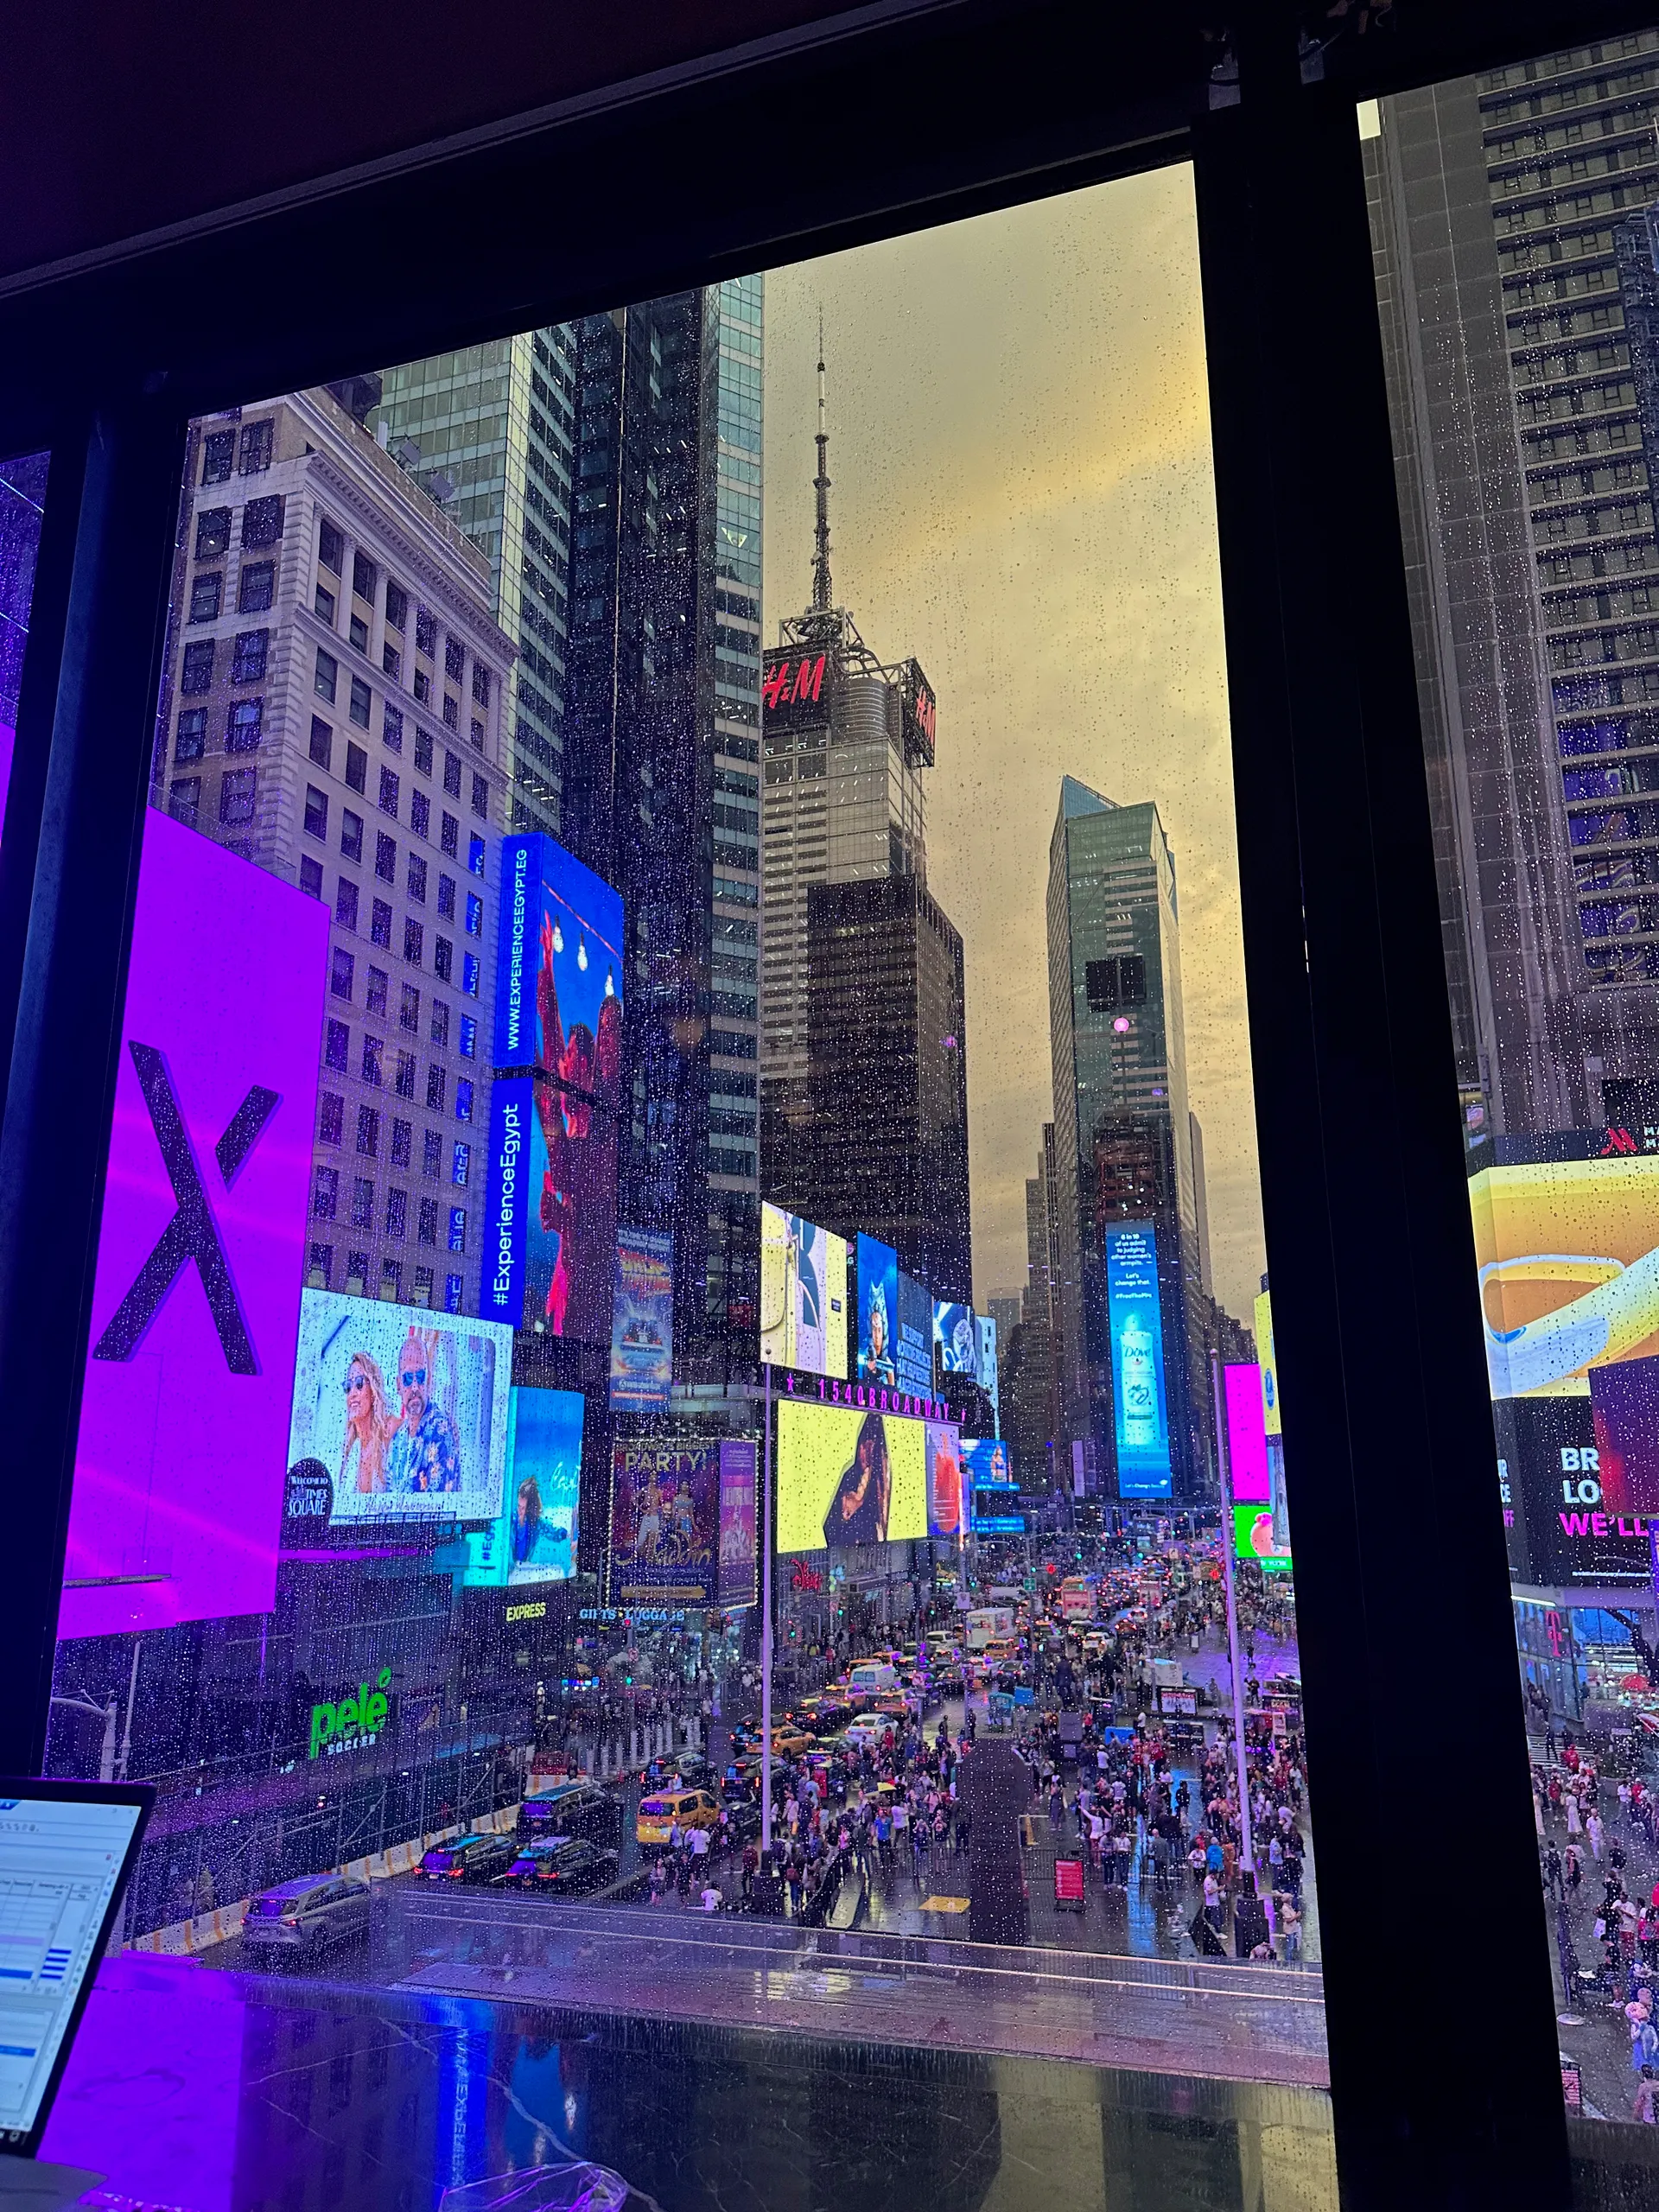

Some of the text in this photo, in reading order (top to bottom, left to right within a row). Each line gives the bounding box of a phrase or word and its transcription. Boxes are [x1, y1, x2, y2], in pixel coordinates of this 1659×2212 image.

[761, 652, 825, 709] H&M
[508, 849, 528, 1051] WWW.EXPERIENCEEGYPT.EG
[493, 1103, 521, 1306] #ExperienceEgypt
[1125, 1346, 1152, 1357] Dove
[625, 1451, 707, 1471] PARTY!
[1560, 1447, 1601, 1471] BR
[306, 1489, 327, 1499] TIMES
[1562, 1479, 1603, 1503] LO
[288, 1500, 326, 1516] SQUARE
[1559, 1512, 1649, 1536] WE'LL
[506, 1602, 547, 1622] EXPRESS
